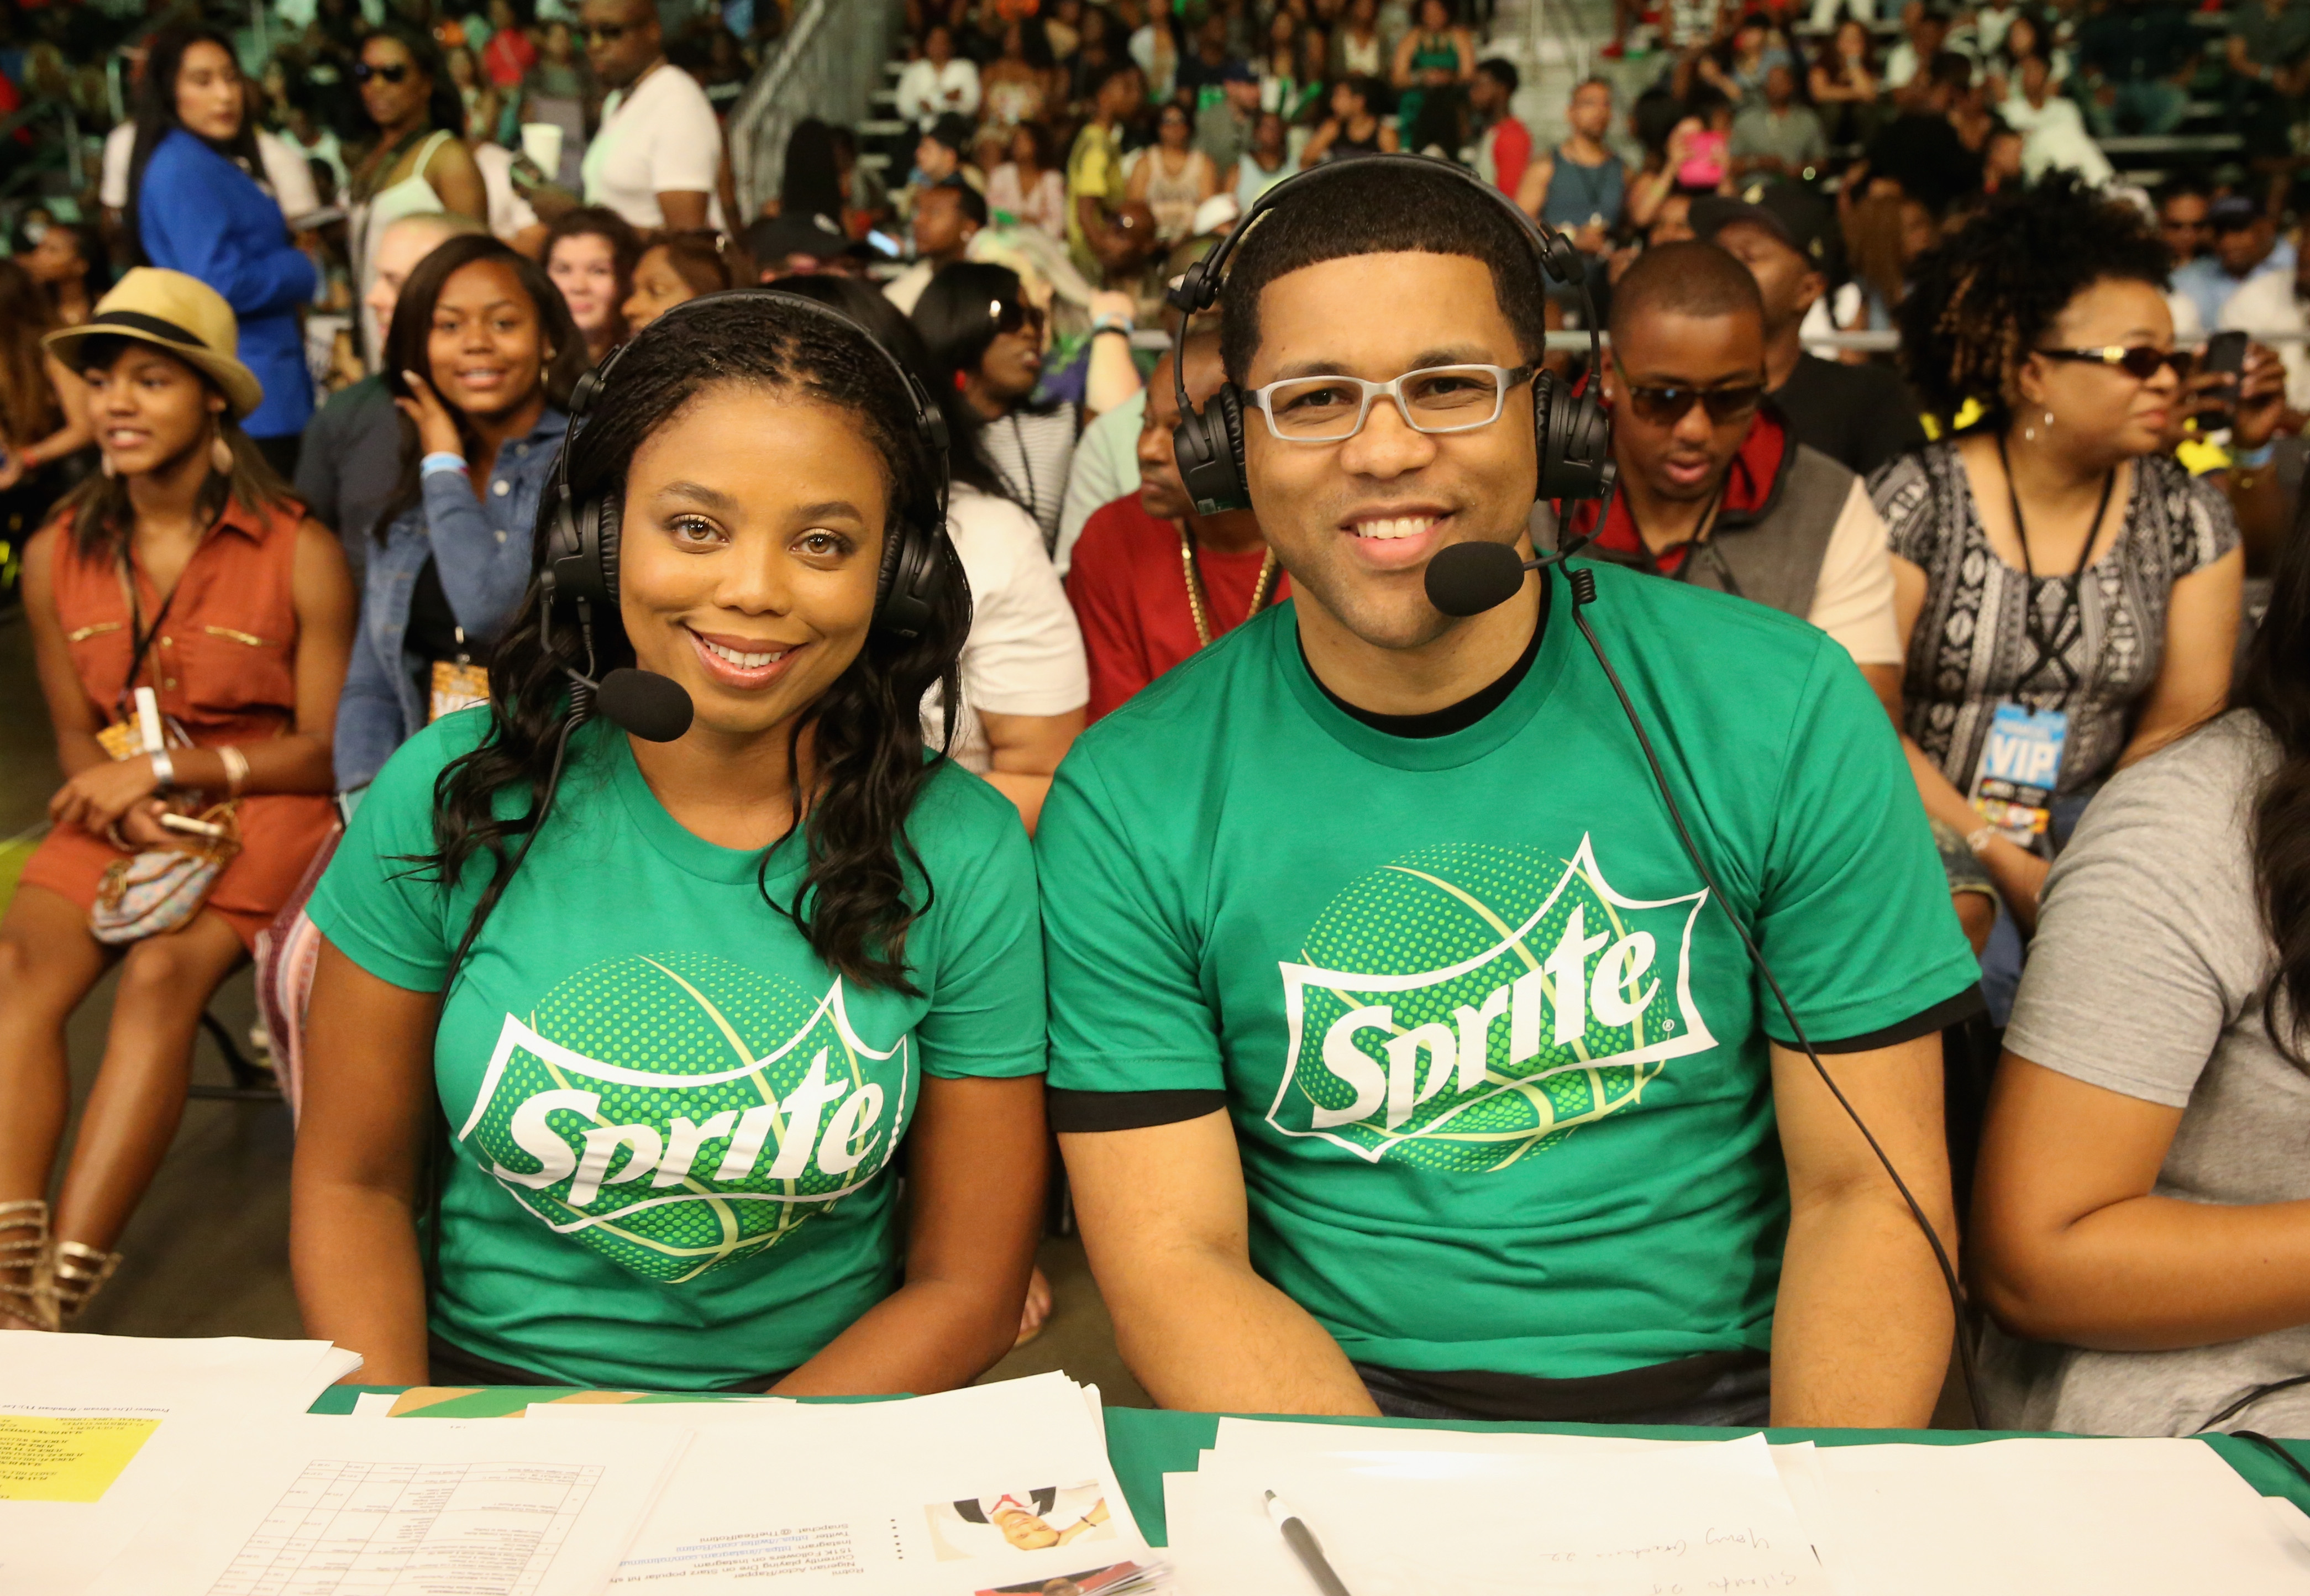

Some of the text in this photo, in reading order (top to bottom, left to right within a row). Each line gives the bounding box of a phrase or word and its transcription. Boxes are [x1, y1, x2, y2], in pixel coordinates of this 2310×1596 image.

[1991, 734, 2057, 782] VIP
[1311, 902, 1661, 1132] Sprite
[492, 1046, 884, 1207] Sprite
[700, 1529, 792, 1542] @TheRealRotimi
[769, 1551, 821, 1561] Followers
[805, 1554, 854, 1564] Currently
[694, 1558, 749, 1568] Instagram
[763, 1558, 801, 1568] playing
[645, 1571, 686, 1580] popular
[733, 1562, 855, 1578] Nigerian Actor/Rapper
